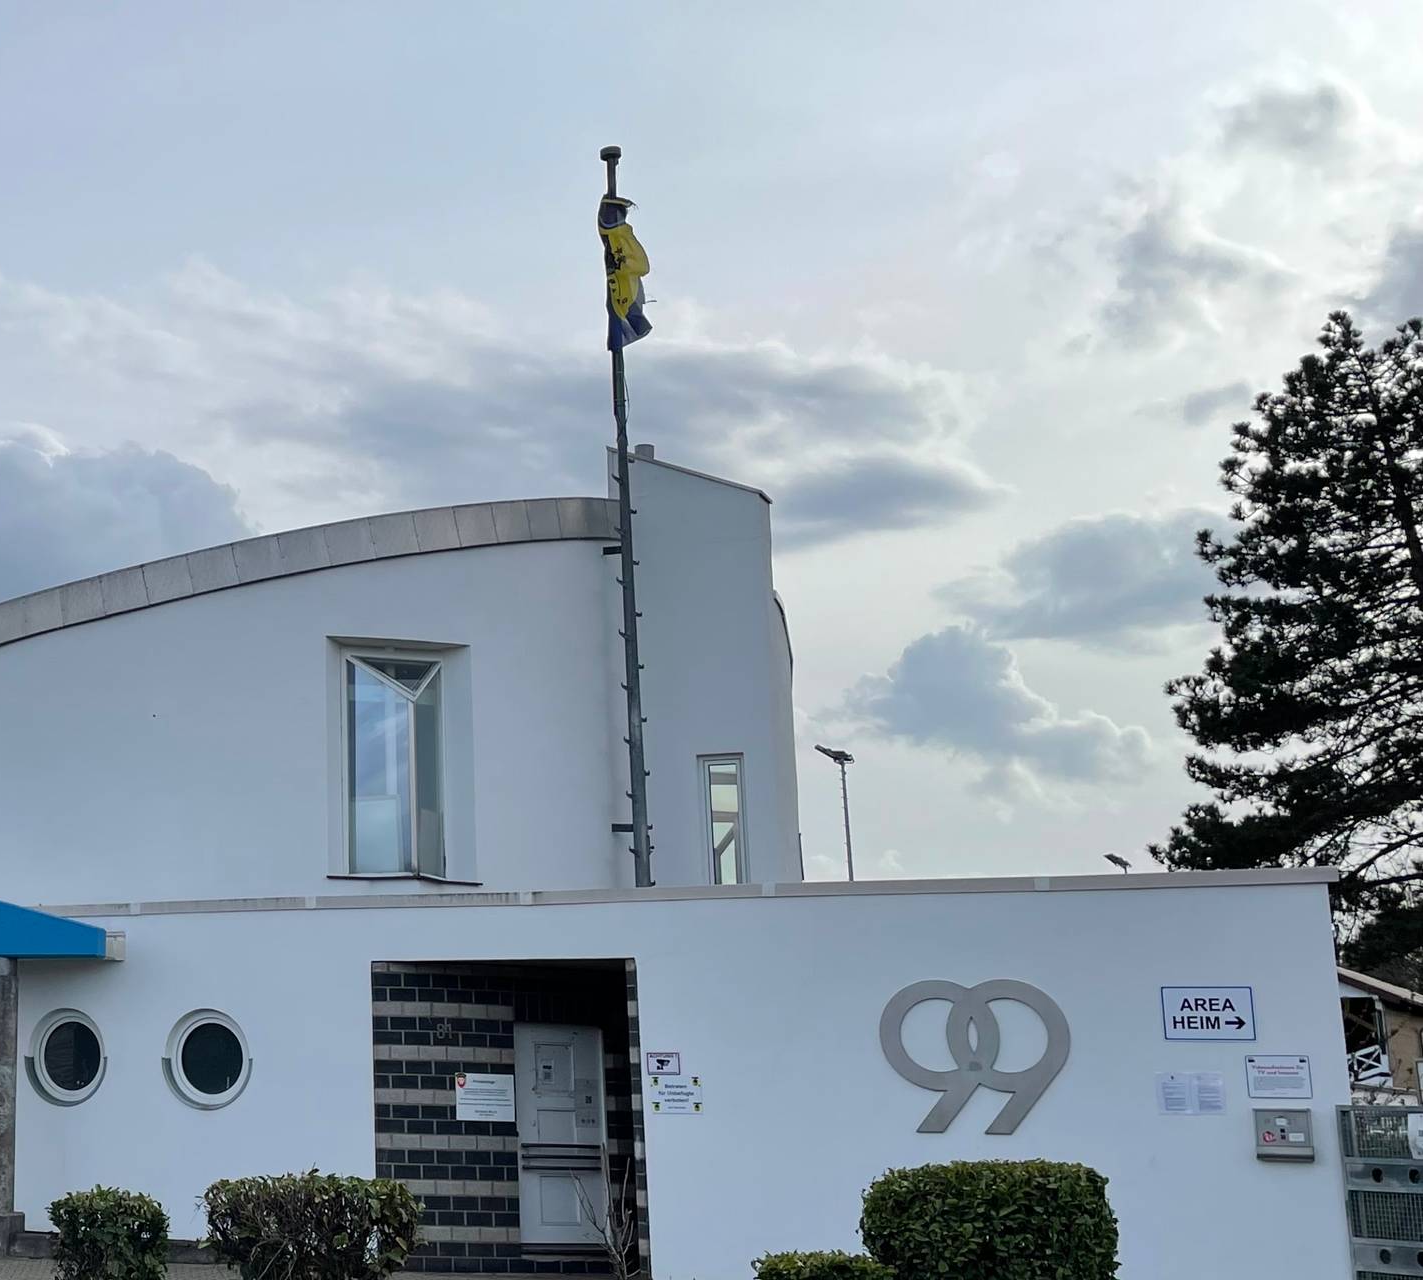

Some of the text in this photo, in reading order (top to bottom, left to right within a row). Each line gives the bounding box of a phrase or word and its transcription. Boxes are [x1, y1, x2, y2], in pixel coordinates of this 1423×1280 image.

[1180, 998, 1236, 1012] AREA
[1172, 1016, 1221, 1030] HEIM
[879, 979, 1071, 1135] 99
